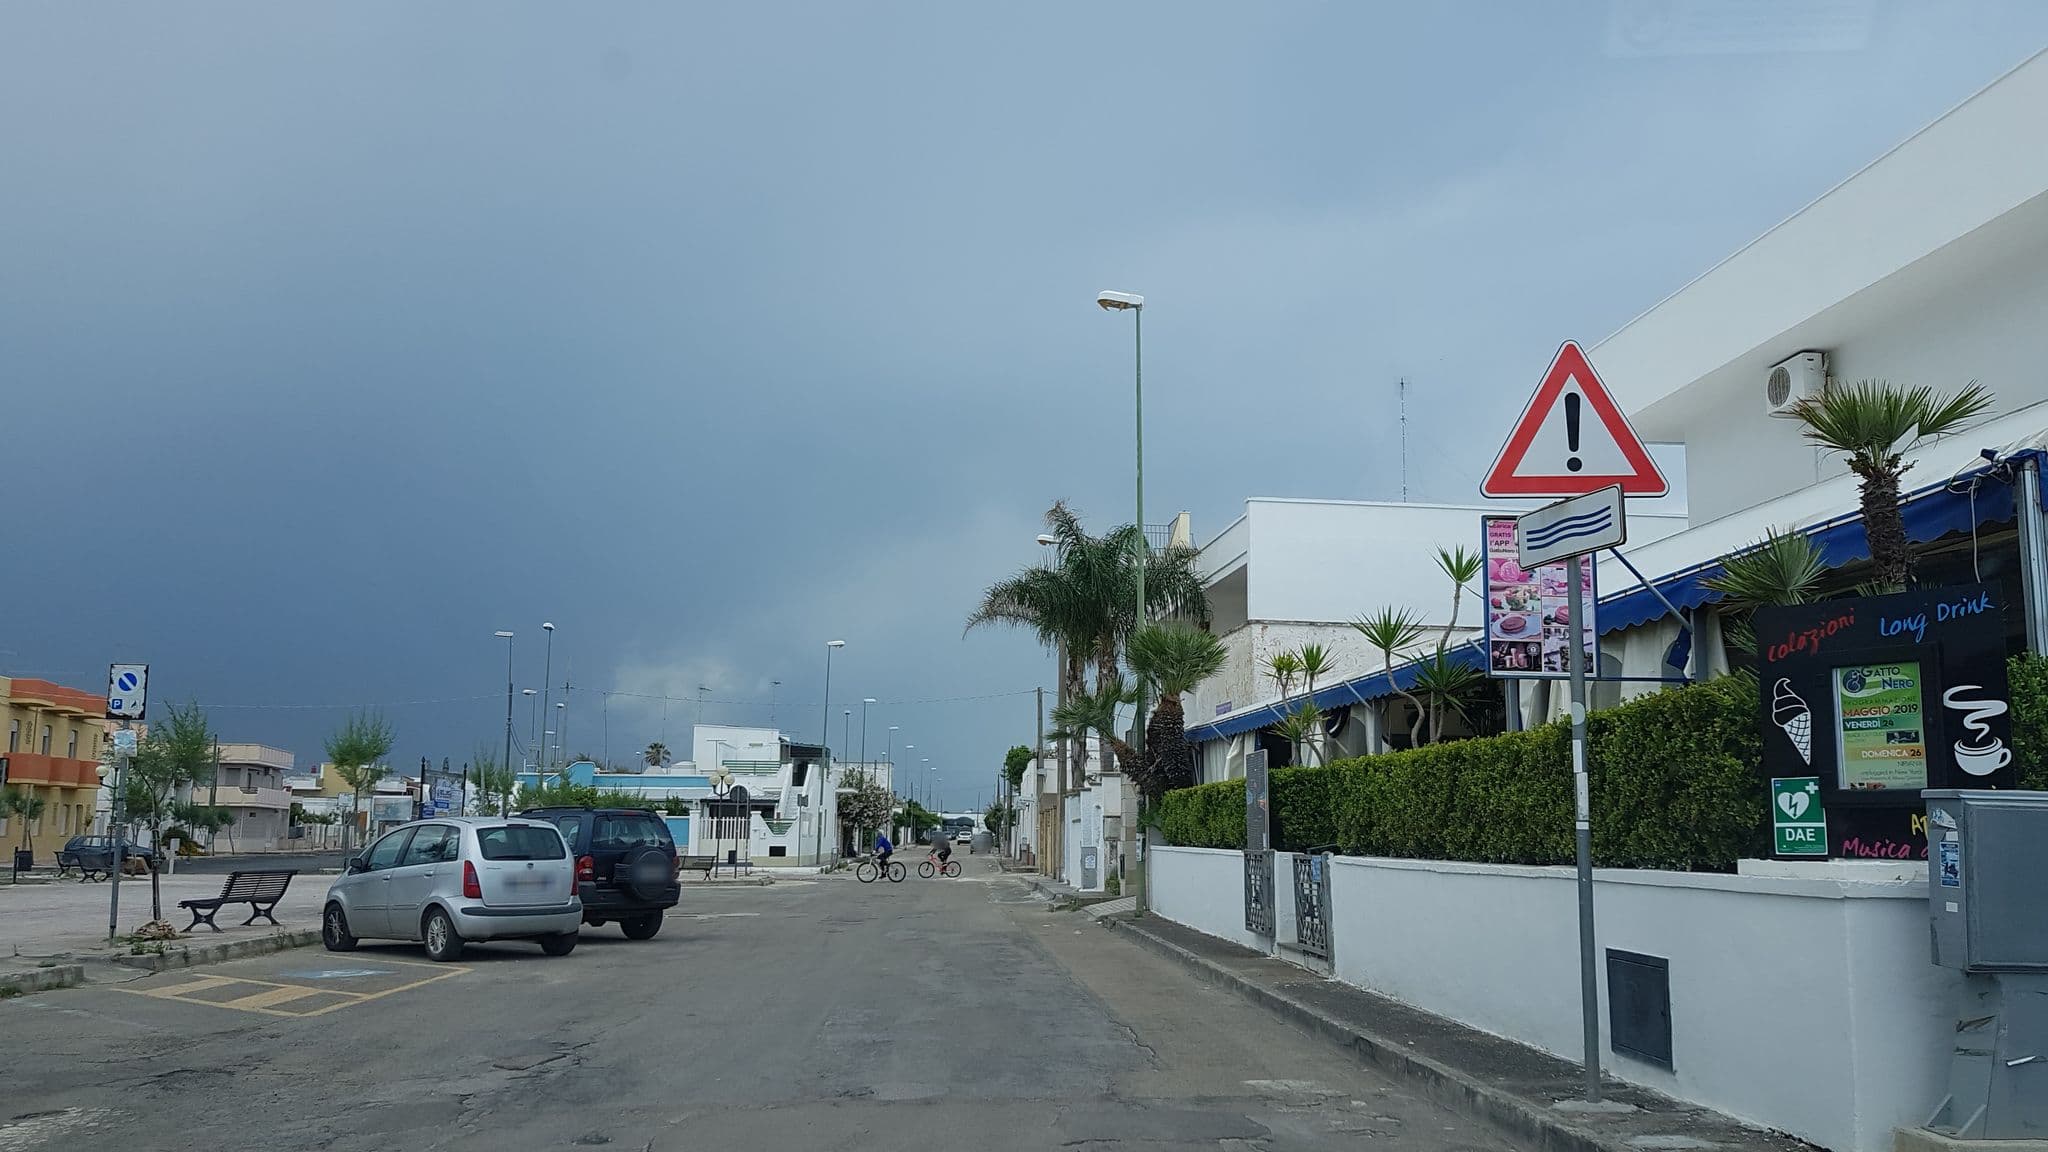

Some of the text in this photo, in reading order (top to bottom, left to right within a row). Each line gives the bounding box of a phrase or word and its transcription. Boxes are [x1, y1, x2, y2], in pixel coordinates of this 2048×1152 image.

[1880, 591, 1994, 643] Long Drink
[1843, 704, 1918, 717] MAGGIO 2019
[1862, 749, 1921, 758] DOMENICA 26
[1785, 828, 1816, 841] DAE
[1842, 838, 1912, 858] Musica
